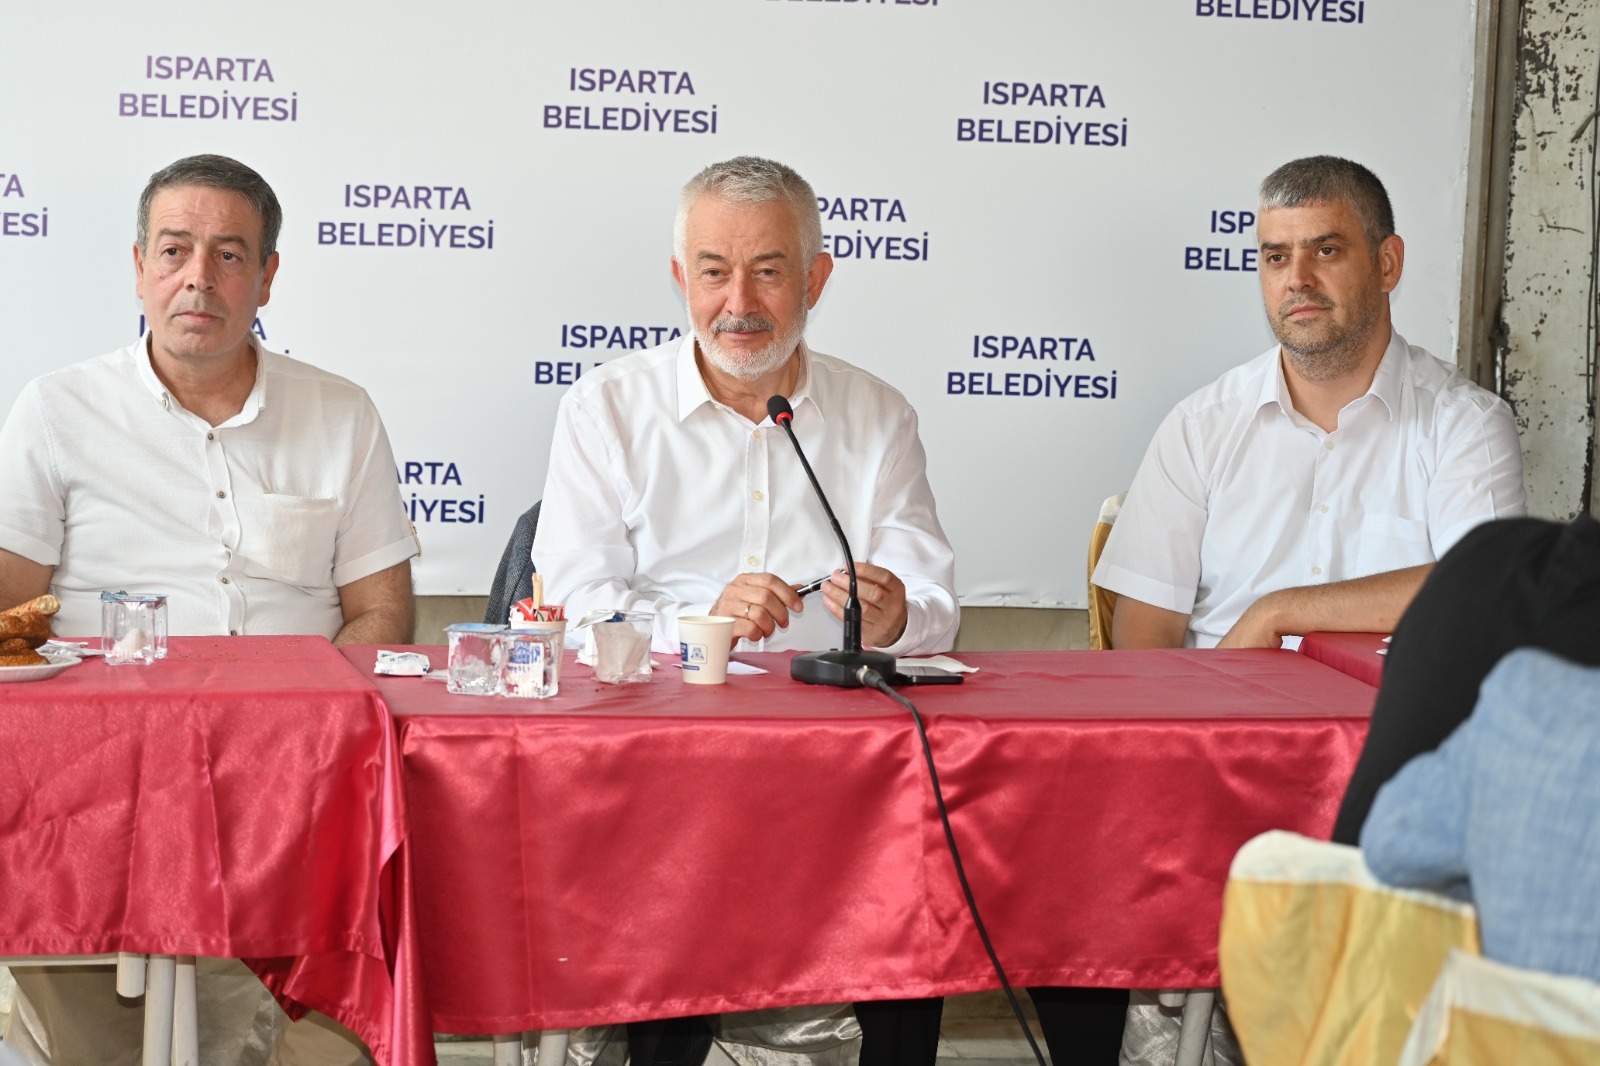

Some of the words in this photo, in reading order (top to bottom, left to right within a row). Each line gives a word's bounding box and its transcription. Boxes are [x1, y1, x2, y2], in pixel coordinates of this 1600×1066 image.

[147, 56, 274, 82] ISPARTA
[571, 68, 695, 95] ISPARTA
[120, 90, 297, 121] BELEDİYESİ
[984, 82, 1105, 108] ISPARTA
[544, 102, 716, 133] BELEDİYESİ
[958, 116, 1127, 146] BELEDİYESİ
[345, 185, 471, 210] ISPARTA
[318, 218, 493, 249] BELEDİYESİ
[974, 336, 1095, 361] ISPARTA
[948, 369, 1116, 399] BELEDİYESİ
